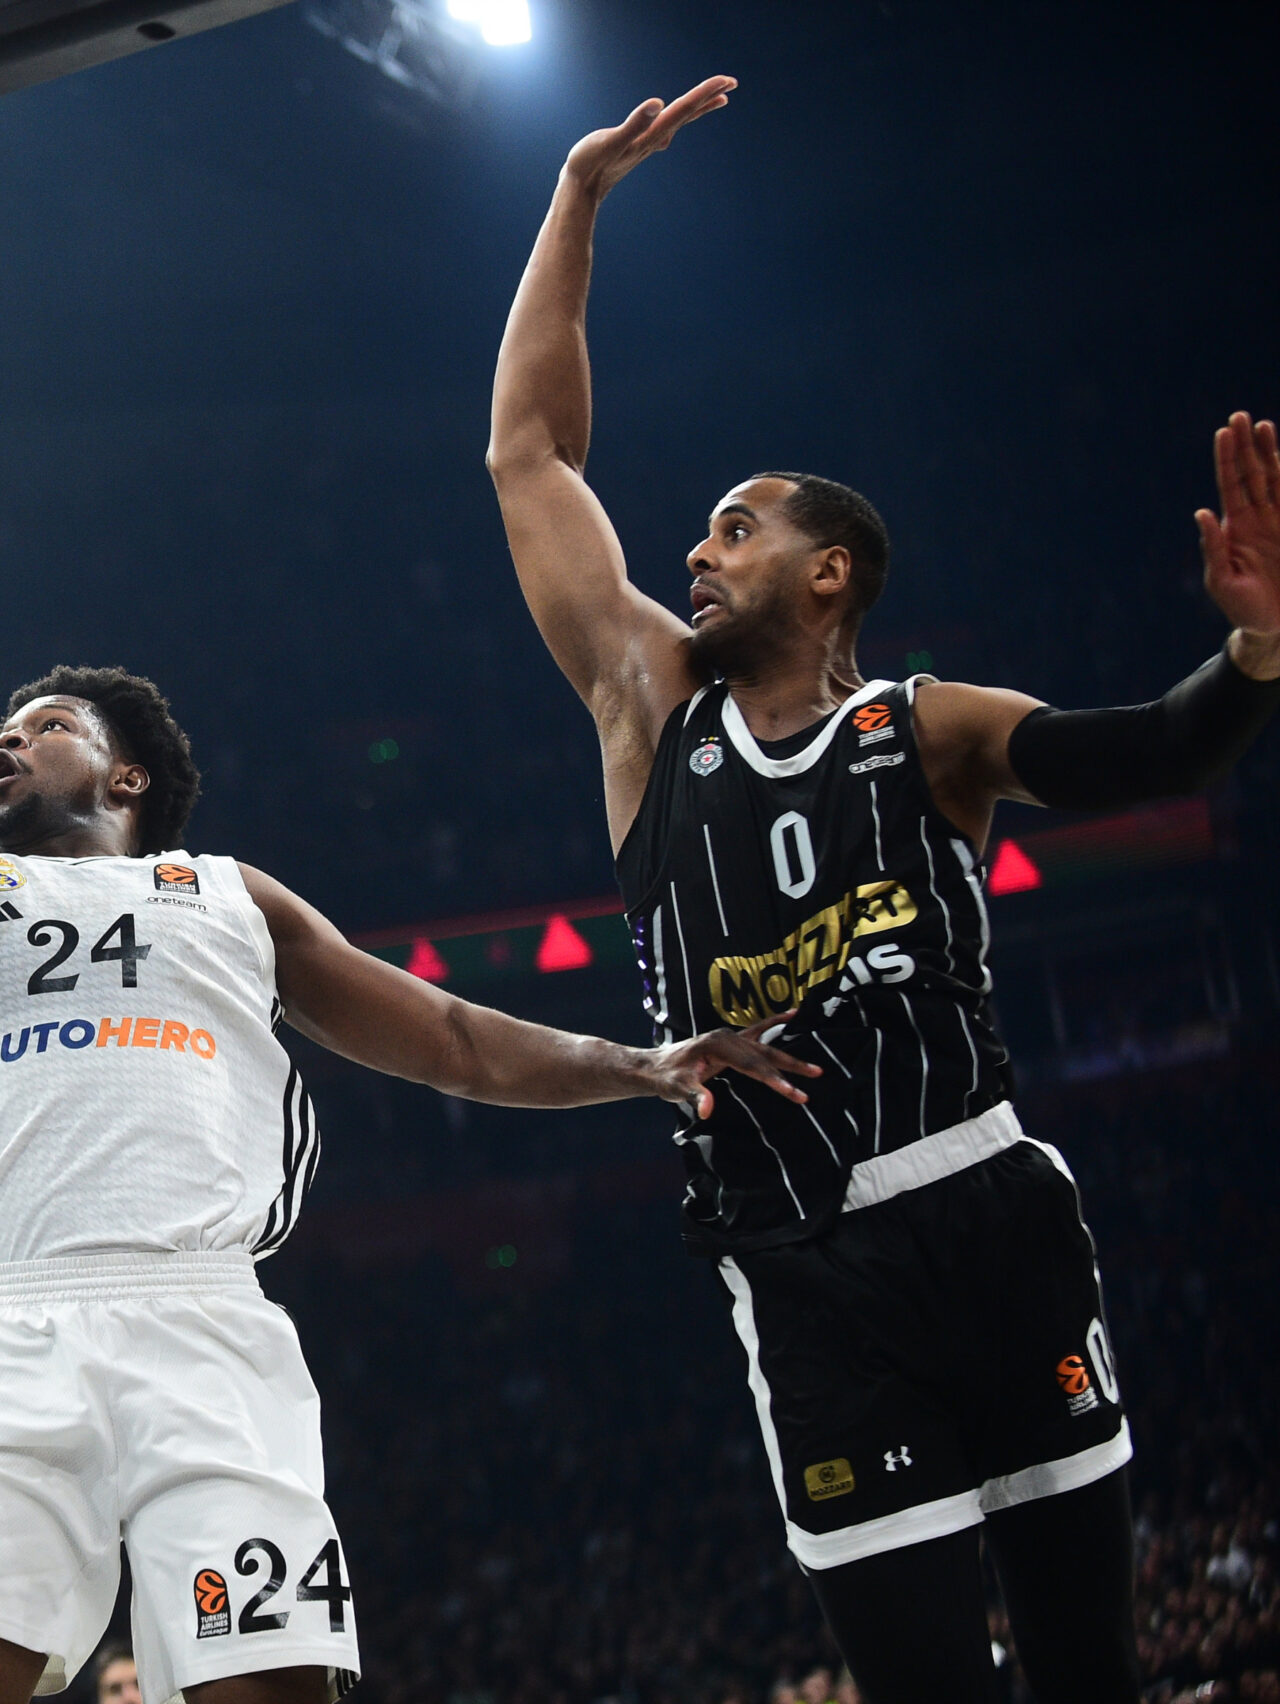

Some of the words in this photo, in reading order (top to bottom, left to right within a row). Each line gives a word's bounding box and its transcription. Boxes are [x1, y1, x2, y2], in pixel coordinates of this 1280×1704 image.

[770, 810, 816, 899] 0
[147, 896, 207, 911] oneteam
[26, 913, 152, 996] 24
[233, 1537, 351, 1635] 24
[200, 1611, 228, 1624] TURKISH
[201, 1620, 228, 1631] AIRLINES
